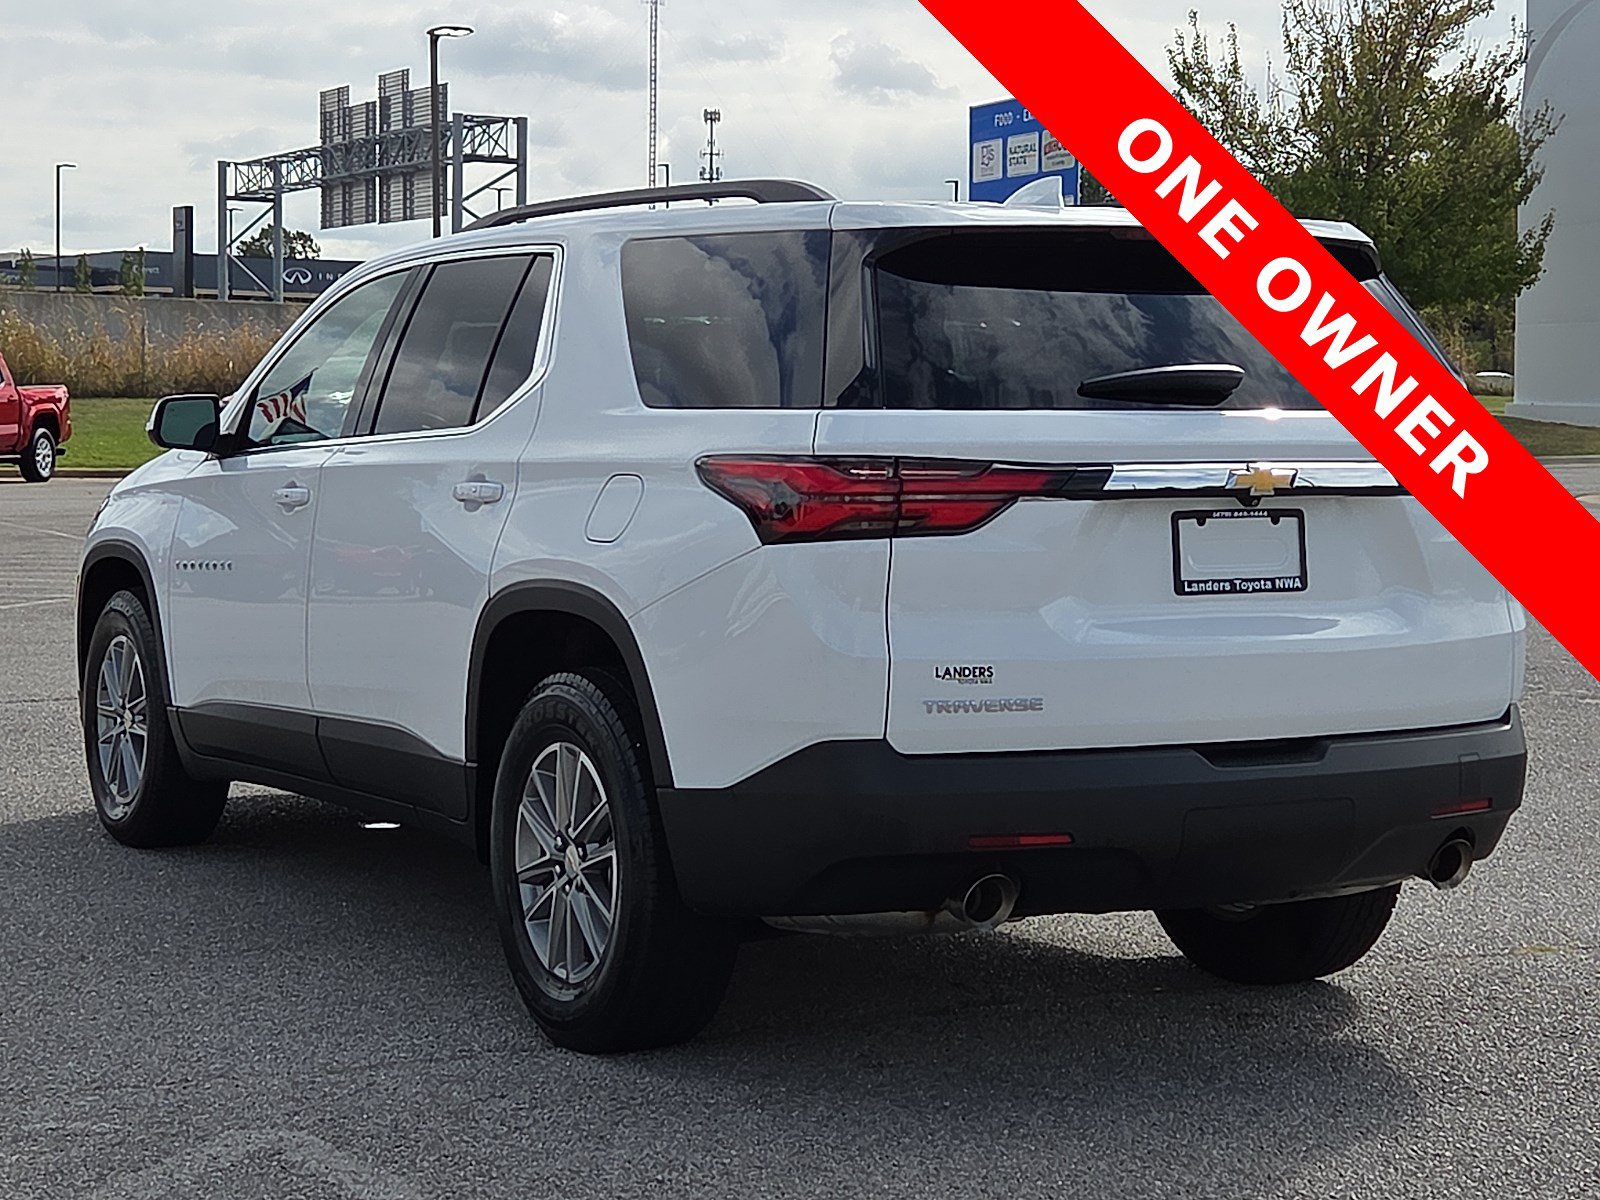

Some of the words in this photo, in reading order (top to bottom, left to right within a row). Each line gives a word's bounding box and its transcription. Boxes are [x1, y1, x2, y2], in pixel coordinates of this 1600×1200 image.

[1184, 580, 1231, 592] Landers
[1234, 579, 1272, 591] Toyota
[1275, 577, 1302, 589] NWA
[935, 665, 994, 680] LANDERS
[922, 698, 1043, 714] TRAVERSE
